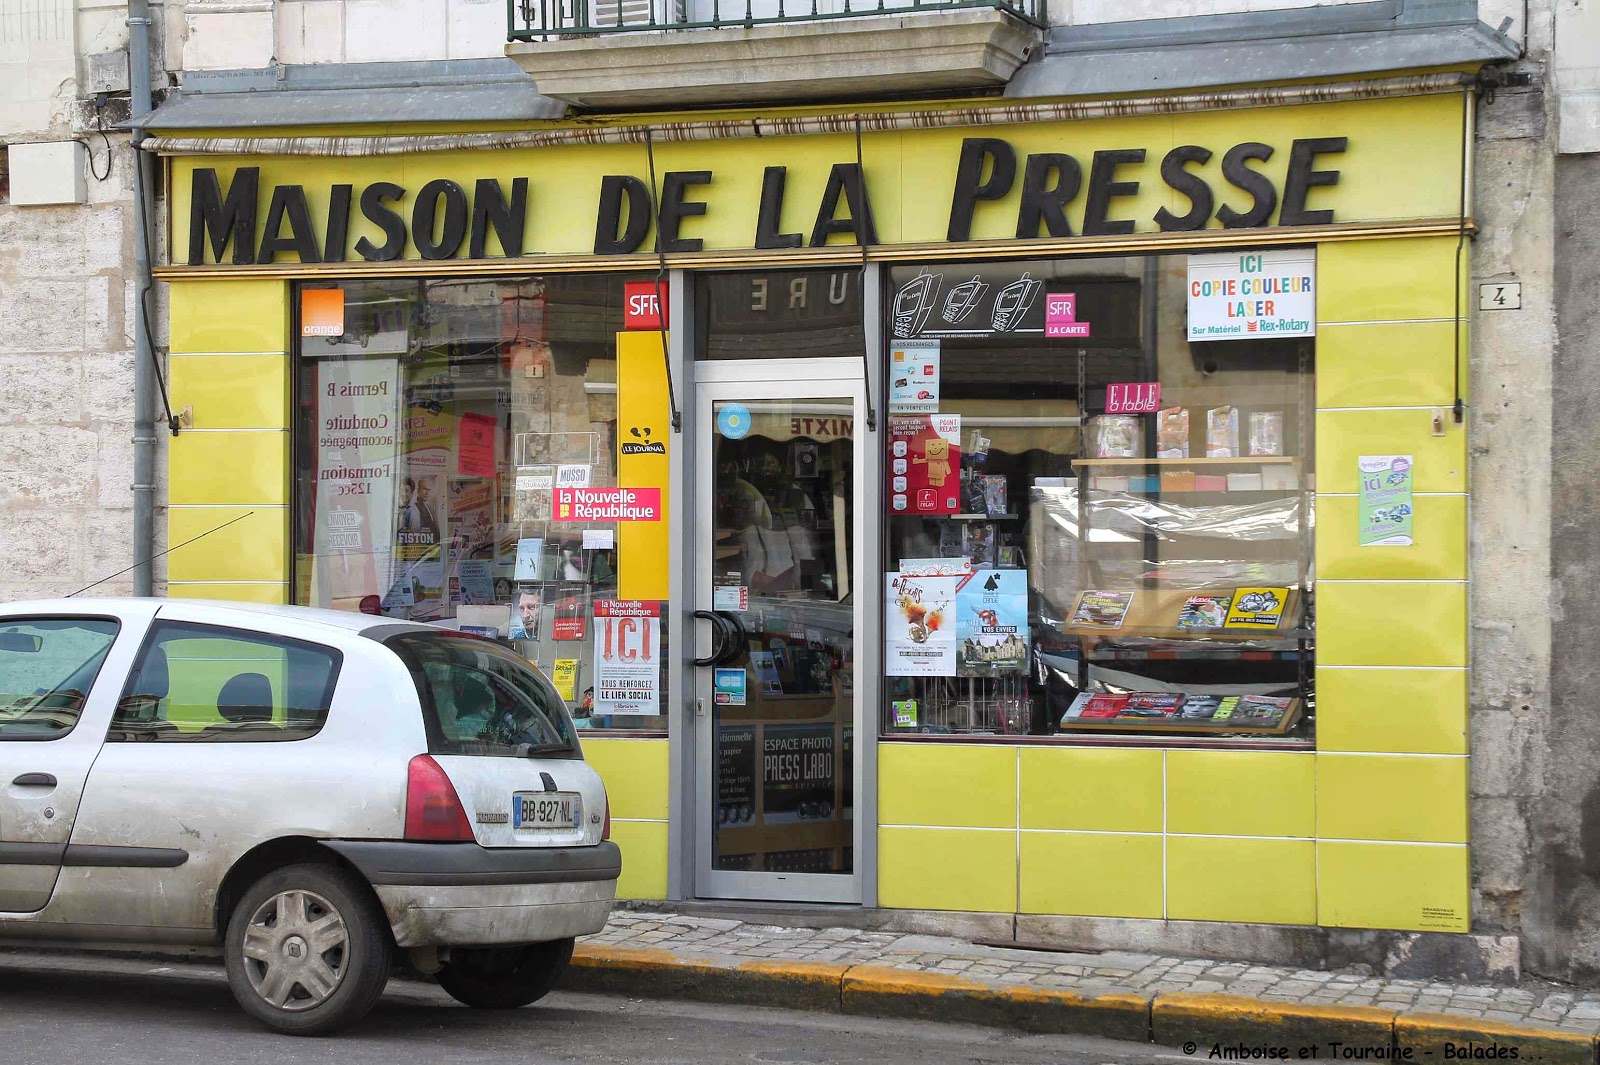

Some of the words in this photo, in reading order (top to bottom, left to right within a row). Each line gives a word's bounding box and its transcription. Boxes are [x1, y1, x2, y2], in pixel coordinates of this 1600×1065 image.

[187, 166, 529, 266] MAISON
[594, 170, 713, 255] DE
[754, 162, 880, 250] LA
[946, 136, 1348, 243] PRESSE
[1239, 254, 1263, 273] ICI
[1191, 279, 1236, 297] COPIE
[1241, 276, 1311, 295] COULEUR
[1493, 287, 1506, 305] 4
[629, 294, 660, 316] SFR
[1049, 301, 1072, 316] SFR
[1227, 300, 1275, 318] LASER
[303, 324, 341, 335] orange
[1049, 326, 1059, 334] LA
[1060, 326, 1087, 334] CARTE
[1192, 326, 1207, 335] Sur
[1207, 324, 1241, 334] Matériel
[1109, 384, 1157, 404] ELLE
[1121, 398, 1156, 411] table
[560, 468, 586, 483] MUSSO
[1363, 474, 1382, 492] ici
[559, 489, 572, 503] la
[574, 489, 636, 503] Nouvelle
[574, 503, 654, 520] République
[398, 532, 435, 544] FISTON
[601, 600, 609, 608] la
[609, 600, 643, 608] Nouvelle
[609, 608, 652, 617] République
[602, 617, 652, 664] ICI
[601, 680, 617, 688] VOUS
[619, 680, 653, 688] RENFORCEZ
[601, 691, 610, 700] LE
[611, 691, 627, 700] LIEN
[628, 691, 652, 700] SOCIAL
[764, 738, 799, 751] ESPACE
[801, 736, 832, 750] PHOTO
[764, 754, 800, 781] PRESS
[803, 752, 832, 779] LABO
[521, 800, 573, 822] BB-927-NL
